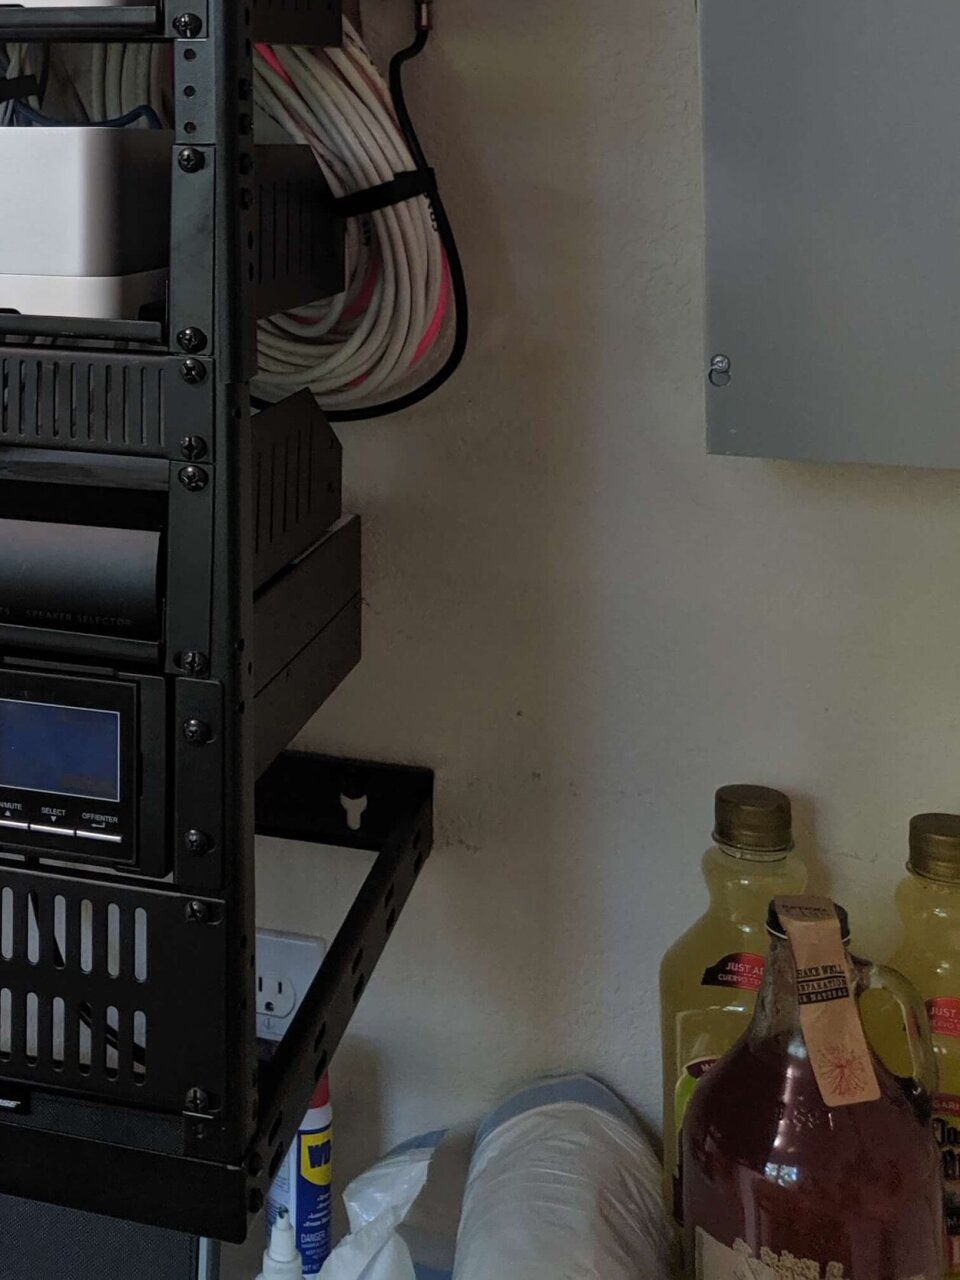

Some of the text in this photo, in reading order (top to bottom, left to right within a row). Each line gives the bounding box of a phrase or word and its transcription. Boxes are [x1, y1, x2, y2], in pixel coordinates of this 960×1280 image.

[41, 806, 66, 816] SELECT
[82, 812, 118, 824] OFF/ENTER
[725, 962, 751, 972] JUST
[930, 1007, 956, 1017] JUST
